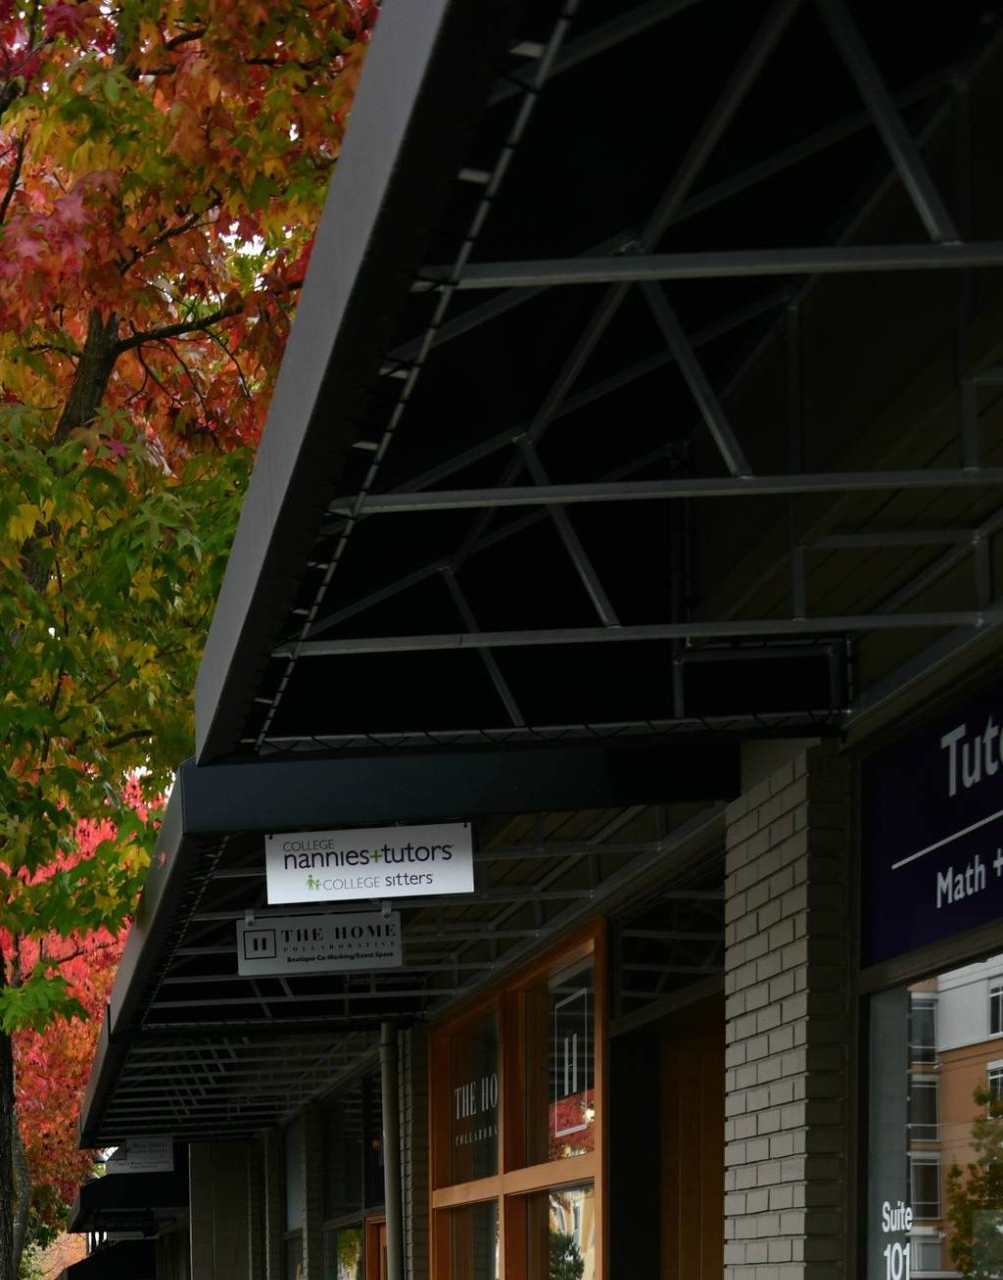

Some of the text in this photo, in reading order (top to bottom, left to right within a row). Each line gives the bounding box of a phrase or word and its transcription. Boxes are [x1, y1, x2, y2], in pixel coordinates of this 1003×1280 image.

[941, 714, 1003, 797] Tut
[283, 839, 335, 851] COLLEGE
[284, 843, 453, 869] nannies+tutors
[322, 873, 433, 891] COLLEGE sitters
[936, 854, 986, 909] Math
[281, 923, 397, 943] THE HOME
[454, 1081, 477, 1119] THE
[882, 1201, 913, 1233] Suite
